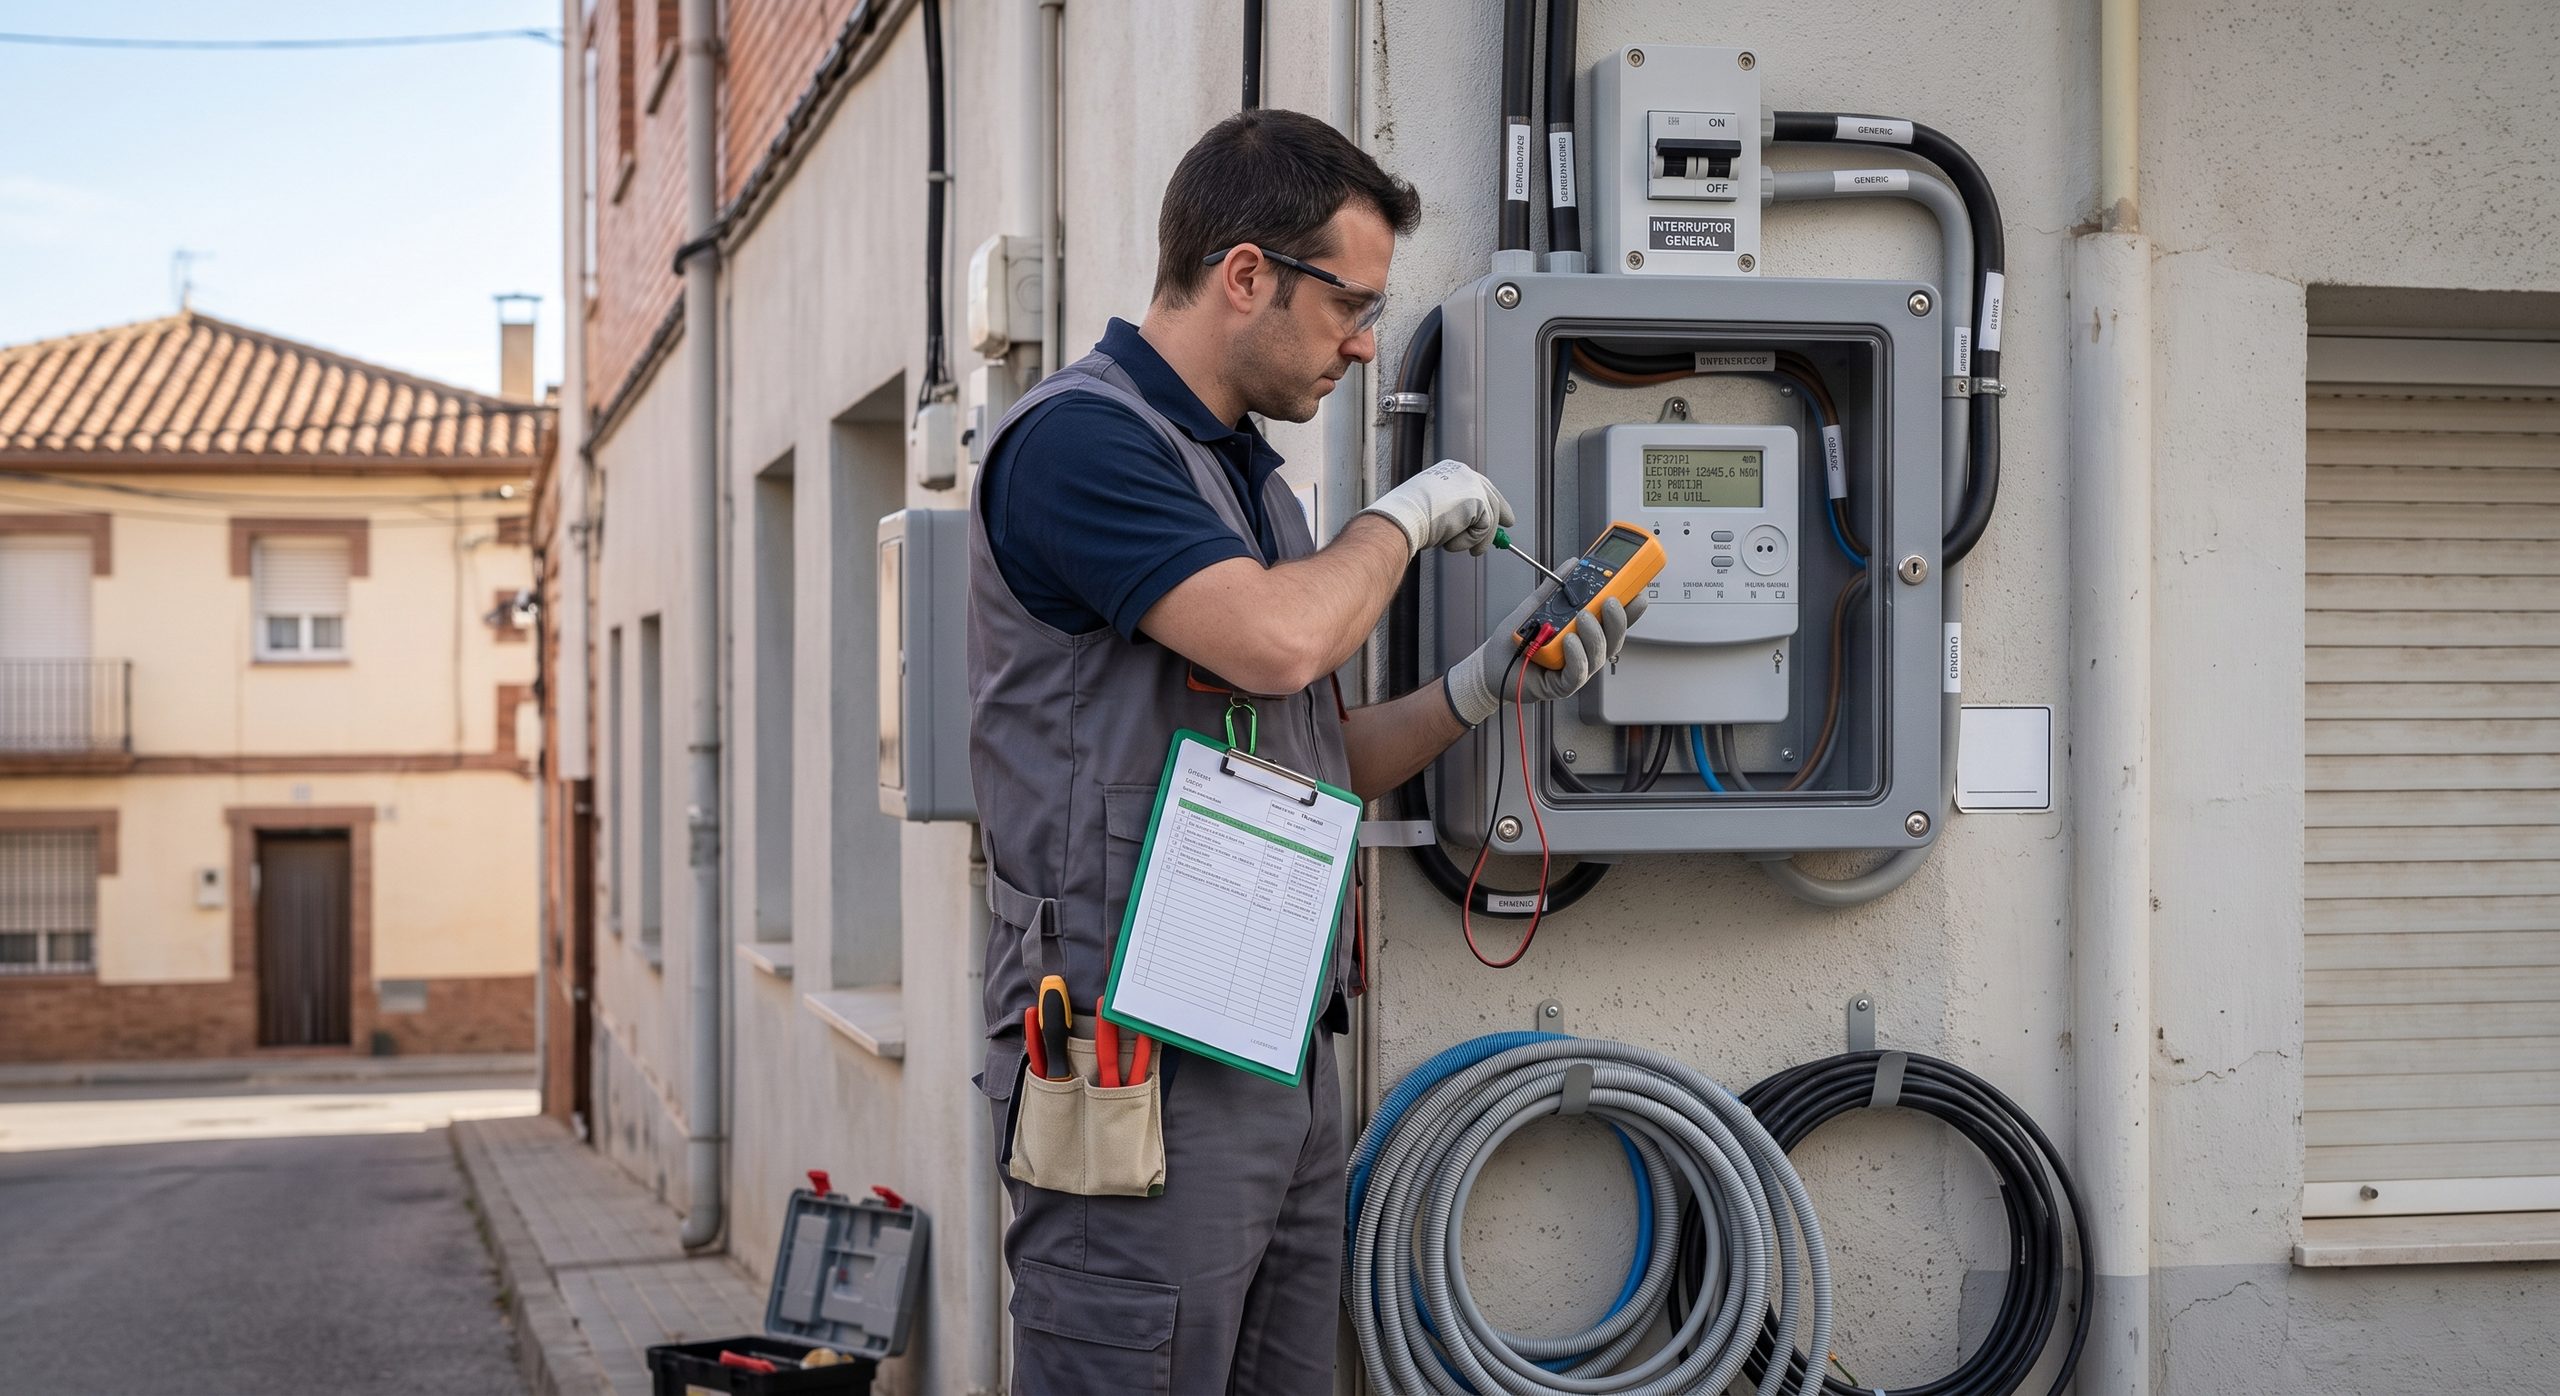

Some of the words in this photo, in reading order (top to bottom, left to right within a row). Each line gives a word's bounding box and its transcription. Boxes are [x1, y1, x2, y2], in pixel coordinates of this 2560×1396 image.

[1708, 118, 1725, 127] ON
[1857, 126, 1893, 135] GENERIC
[1854, 176, 1889, 184] GENERIC
[1706, 183, 1728, 192] OFF
[1652, 221, 1731, 233] INTERRUPTOR
[1665, 236, 1719, 247] GENERAL
